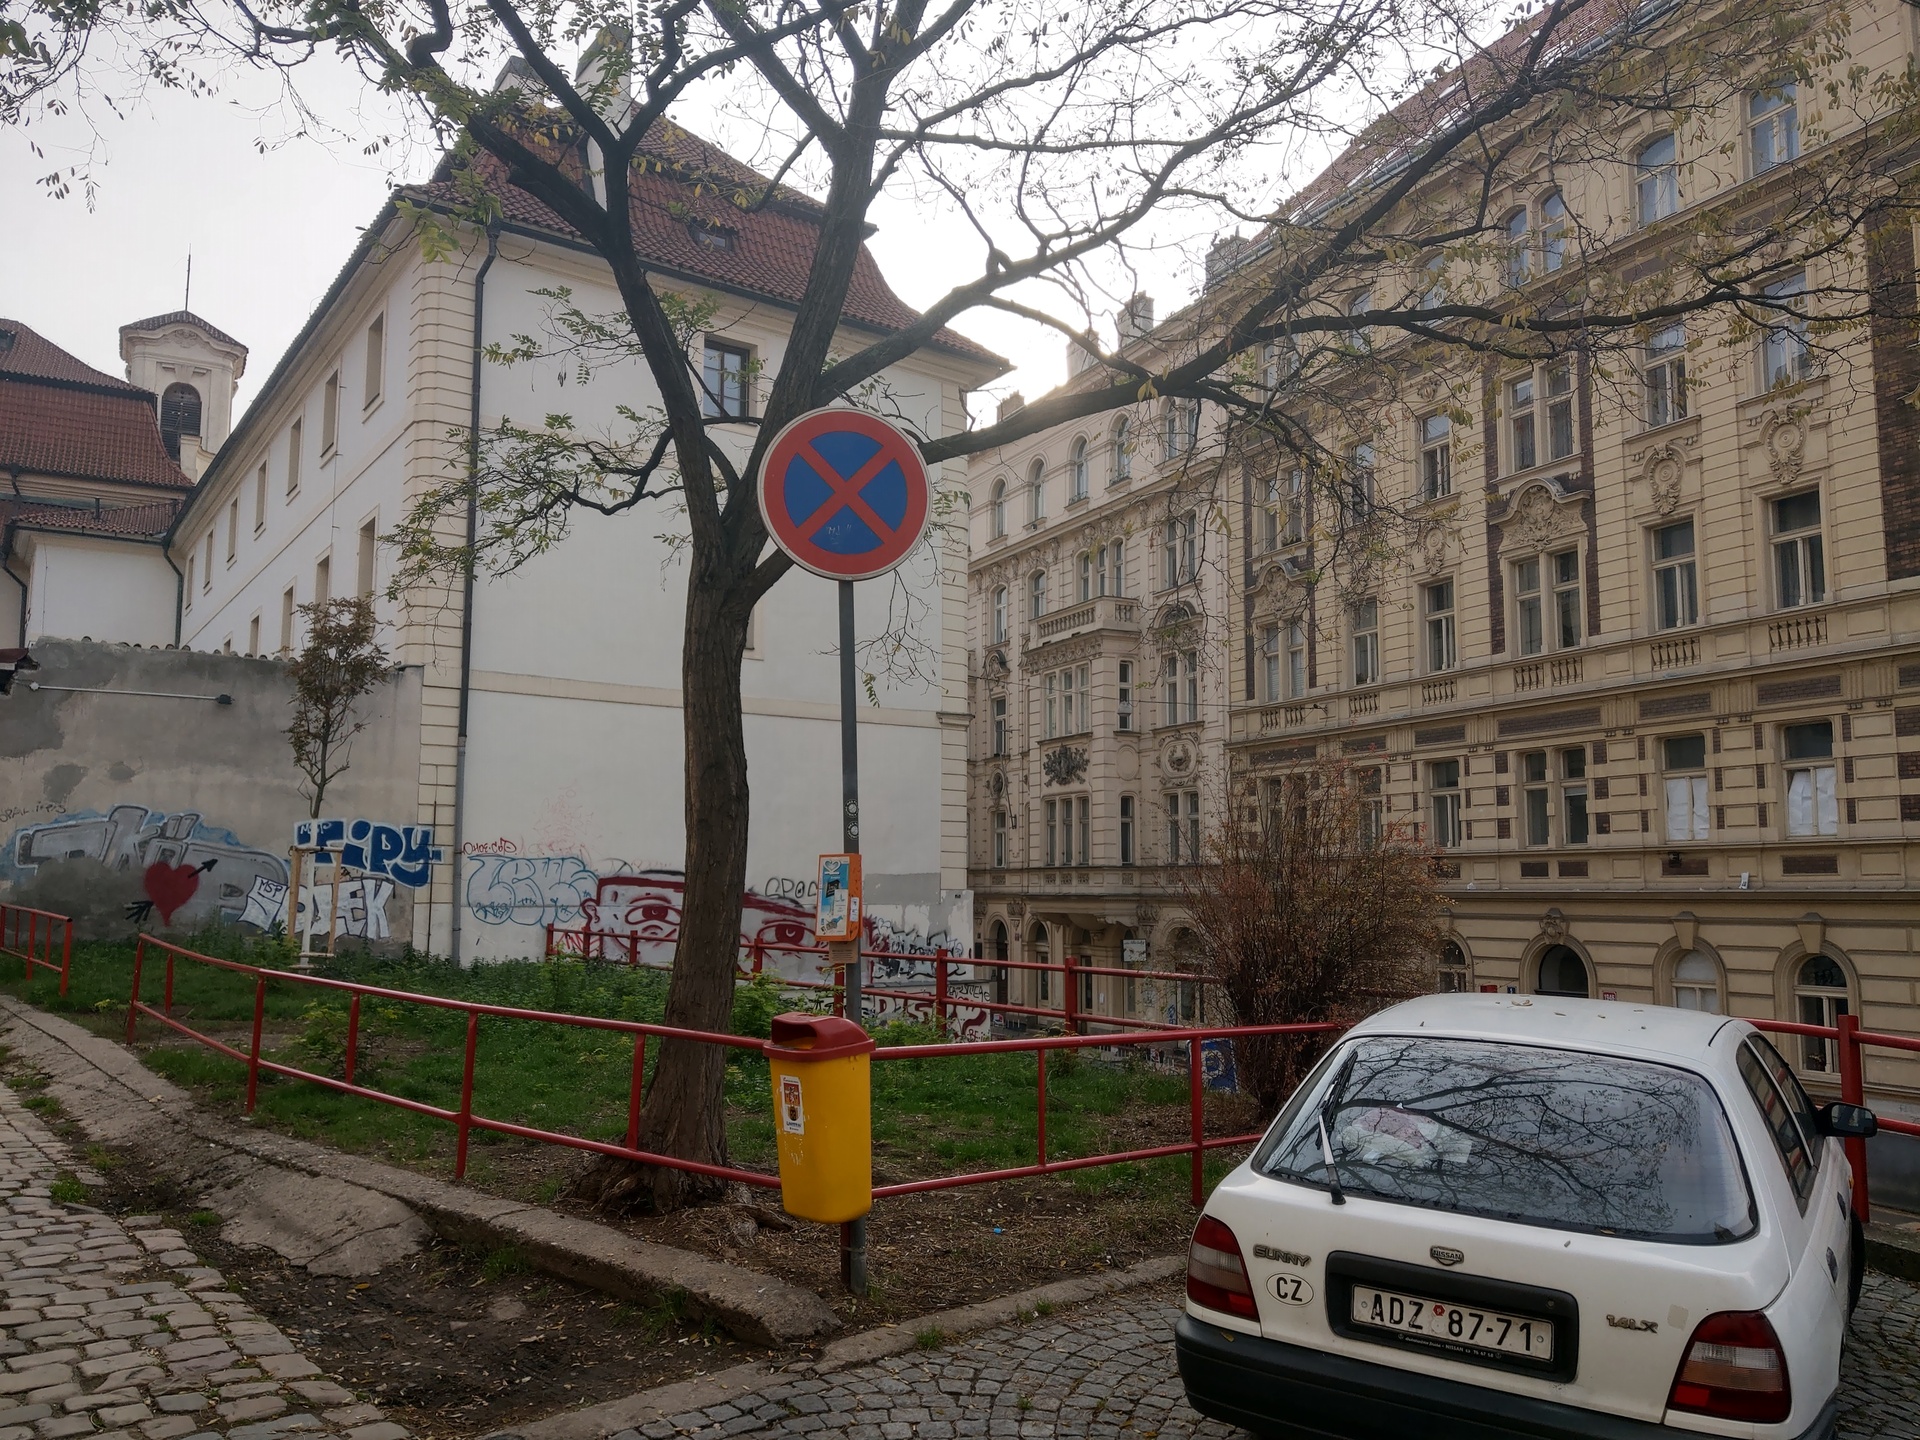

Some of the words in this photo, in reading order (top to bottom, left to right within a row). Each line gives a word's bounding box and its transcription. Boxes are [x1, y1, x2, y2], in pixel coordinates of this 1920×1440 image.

[258, 878, 284, 898] MSP
[1253, 1244, 1312, 1268] SUNNY
[1433, 1249, 1461, 1260] NISSAN
[1276, 1276, 1303, 1303] CZ
[1370, 1293, 1425, 1331] ADZ
[1448, 1308, 1533, 1352] 87-71
